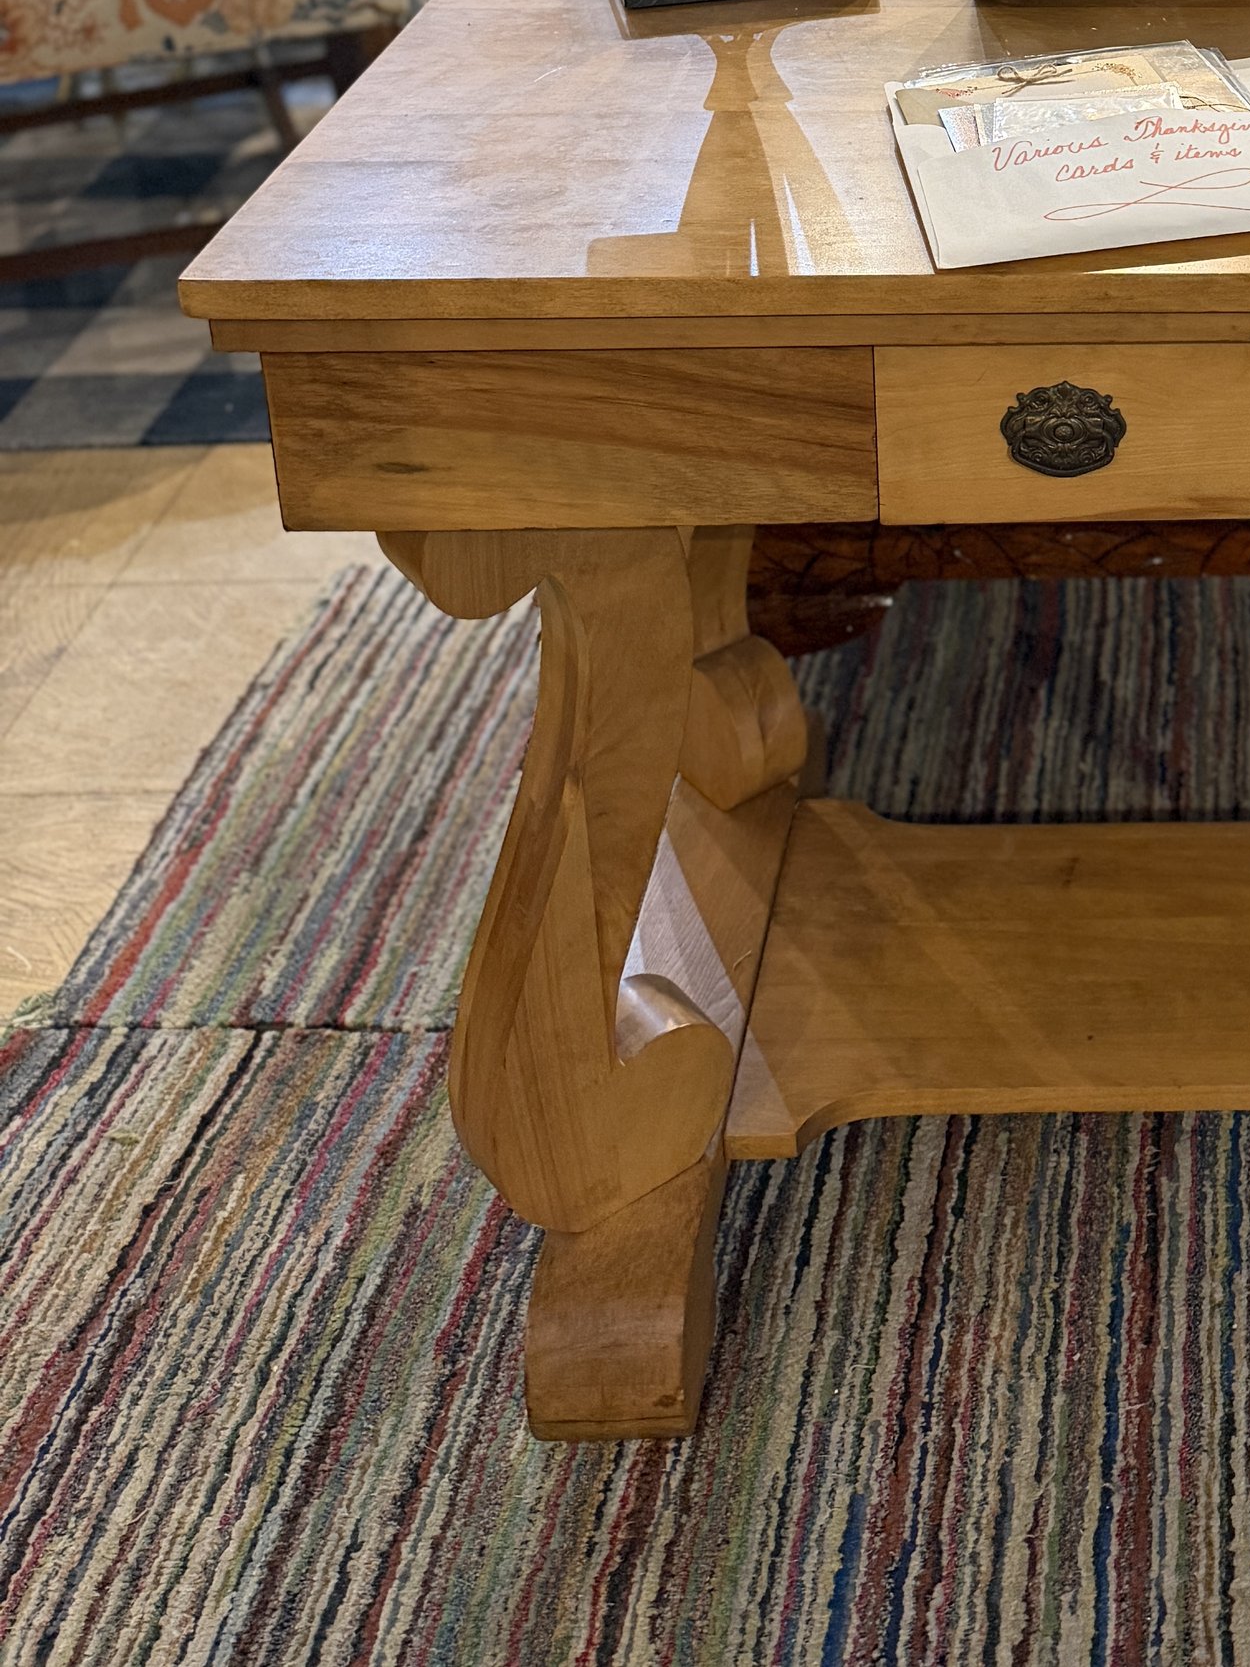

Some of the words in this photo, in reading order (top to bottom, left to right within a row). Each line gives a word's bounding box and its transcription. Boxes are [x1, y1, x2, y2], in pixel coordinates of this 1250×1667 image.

[992, 136, 1109, 171] Various
[1150, 143, 1164, 164] &
[1174, 144, 1242, 161] items
